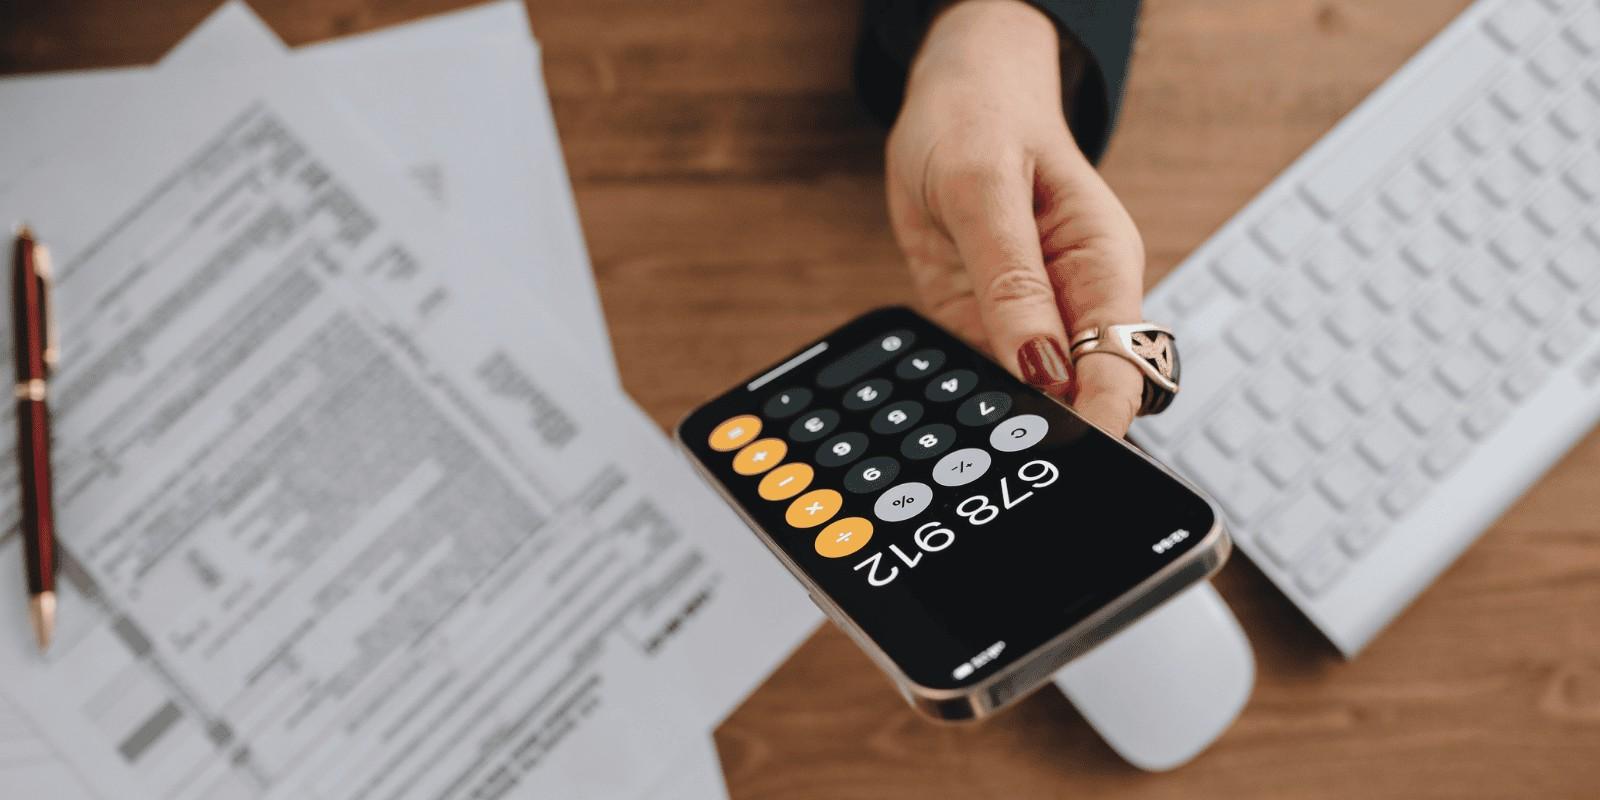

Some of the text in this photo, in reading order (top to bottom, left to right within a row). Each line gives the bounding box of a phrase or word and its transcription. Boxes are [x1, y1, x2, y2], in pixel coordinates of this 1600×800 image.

[911, 358, 930, 371] 1
[940, 377, 959, 393] 4
[856, 386, 879, 402] 2
[978, 401, 996, 416] 7
[804, 417, 825, 433] 3
[918, 433, 939, 448] 8
[1010, 427, 1027, 439] C
[832, 441, 852, 457] 6
[862, 467, 882, 482] 9
[891, 495, 915, 509] %
[853, 459, 1060, 587] 678 912
